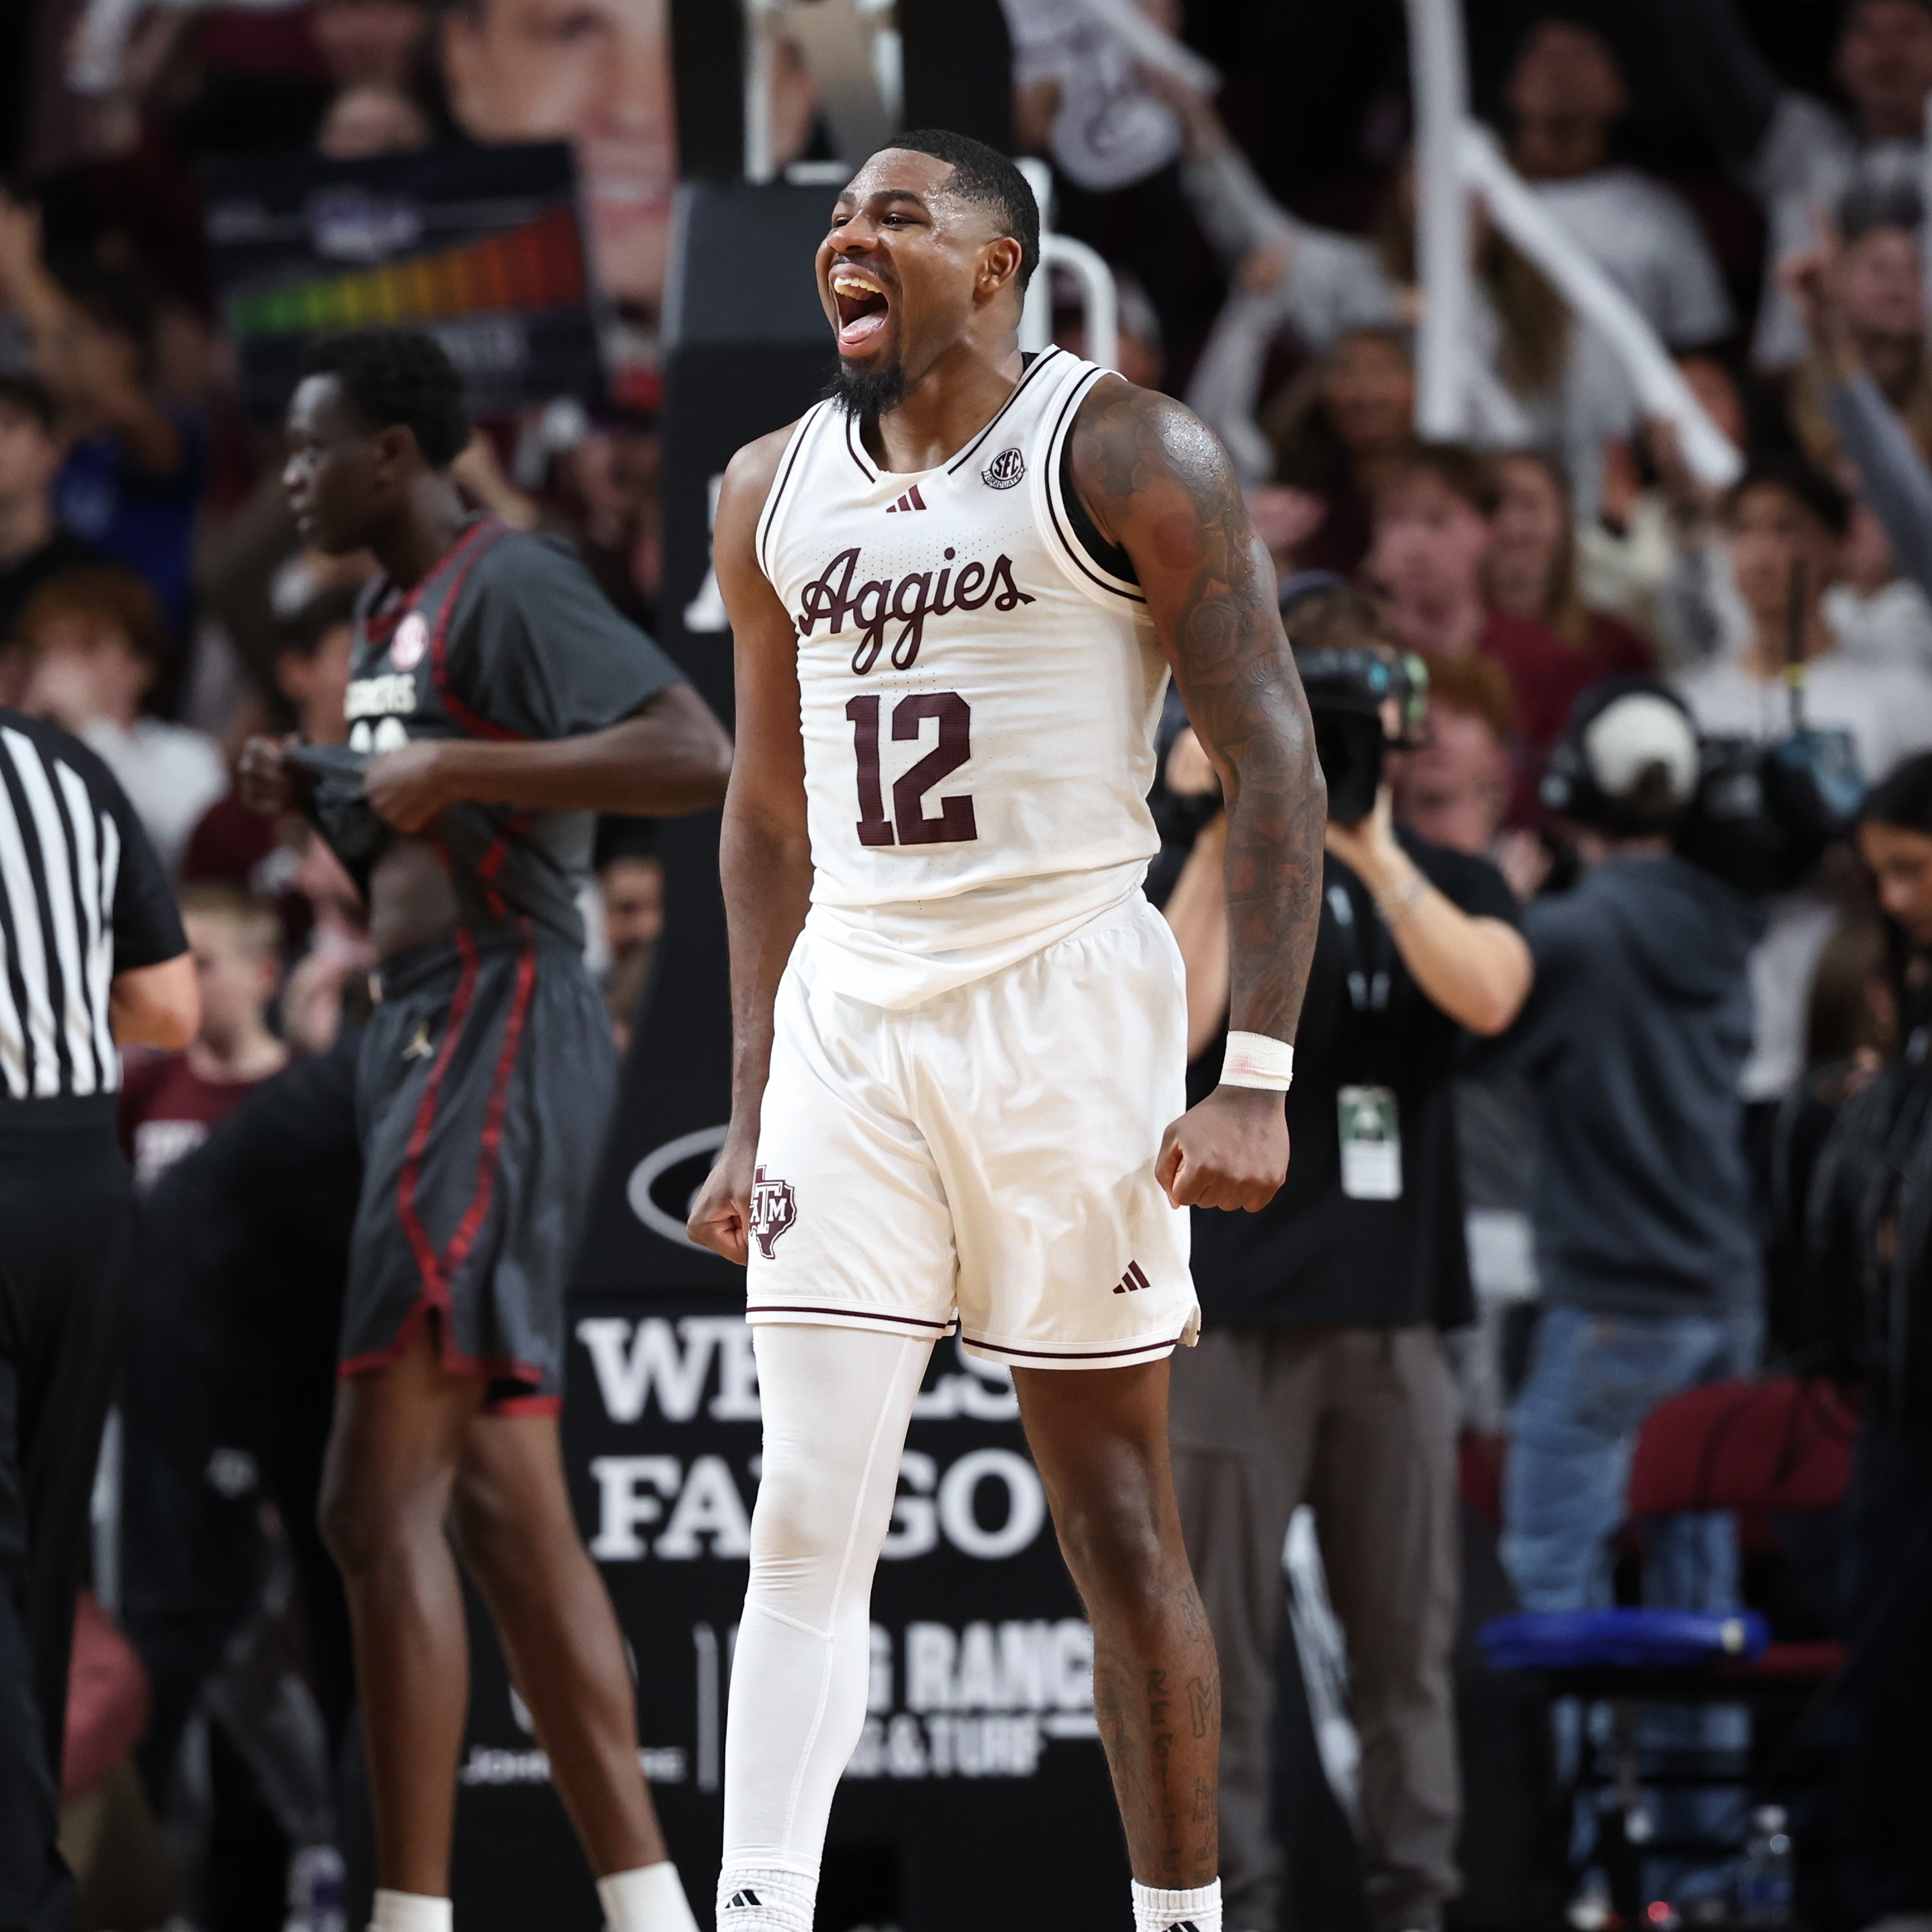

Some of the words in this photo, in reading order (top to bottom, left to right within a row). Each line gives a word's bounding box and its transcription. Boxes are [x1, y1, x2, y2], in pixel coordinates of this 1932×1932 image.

[994, 450, 1019, 478] SEC
[799, 547, 1036, 675] Aggies
[846, 692, 978, 846] 12
[589, 1448, 1046, 1561] FAGO
